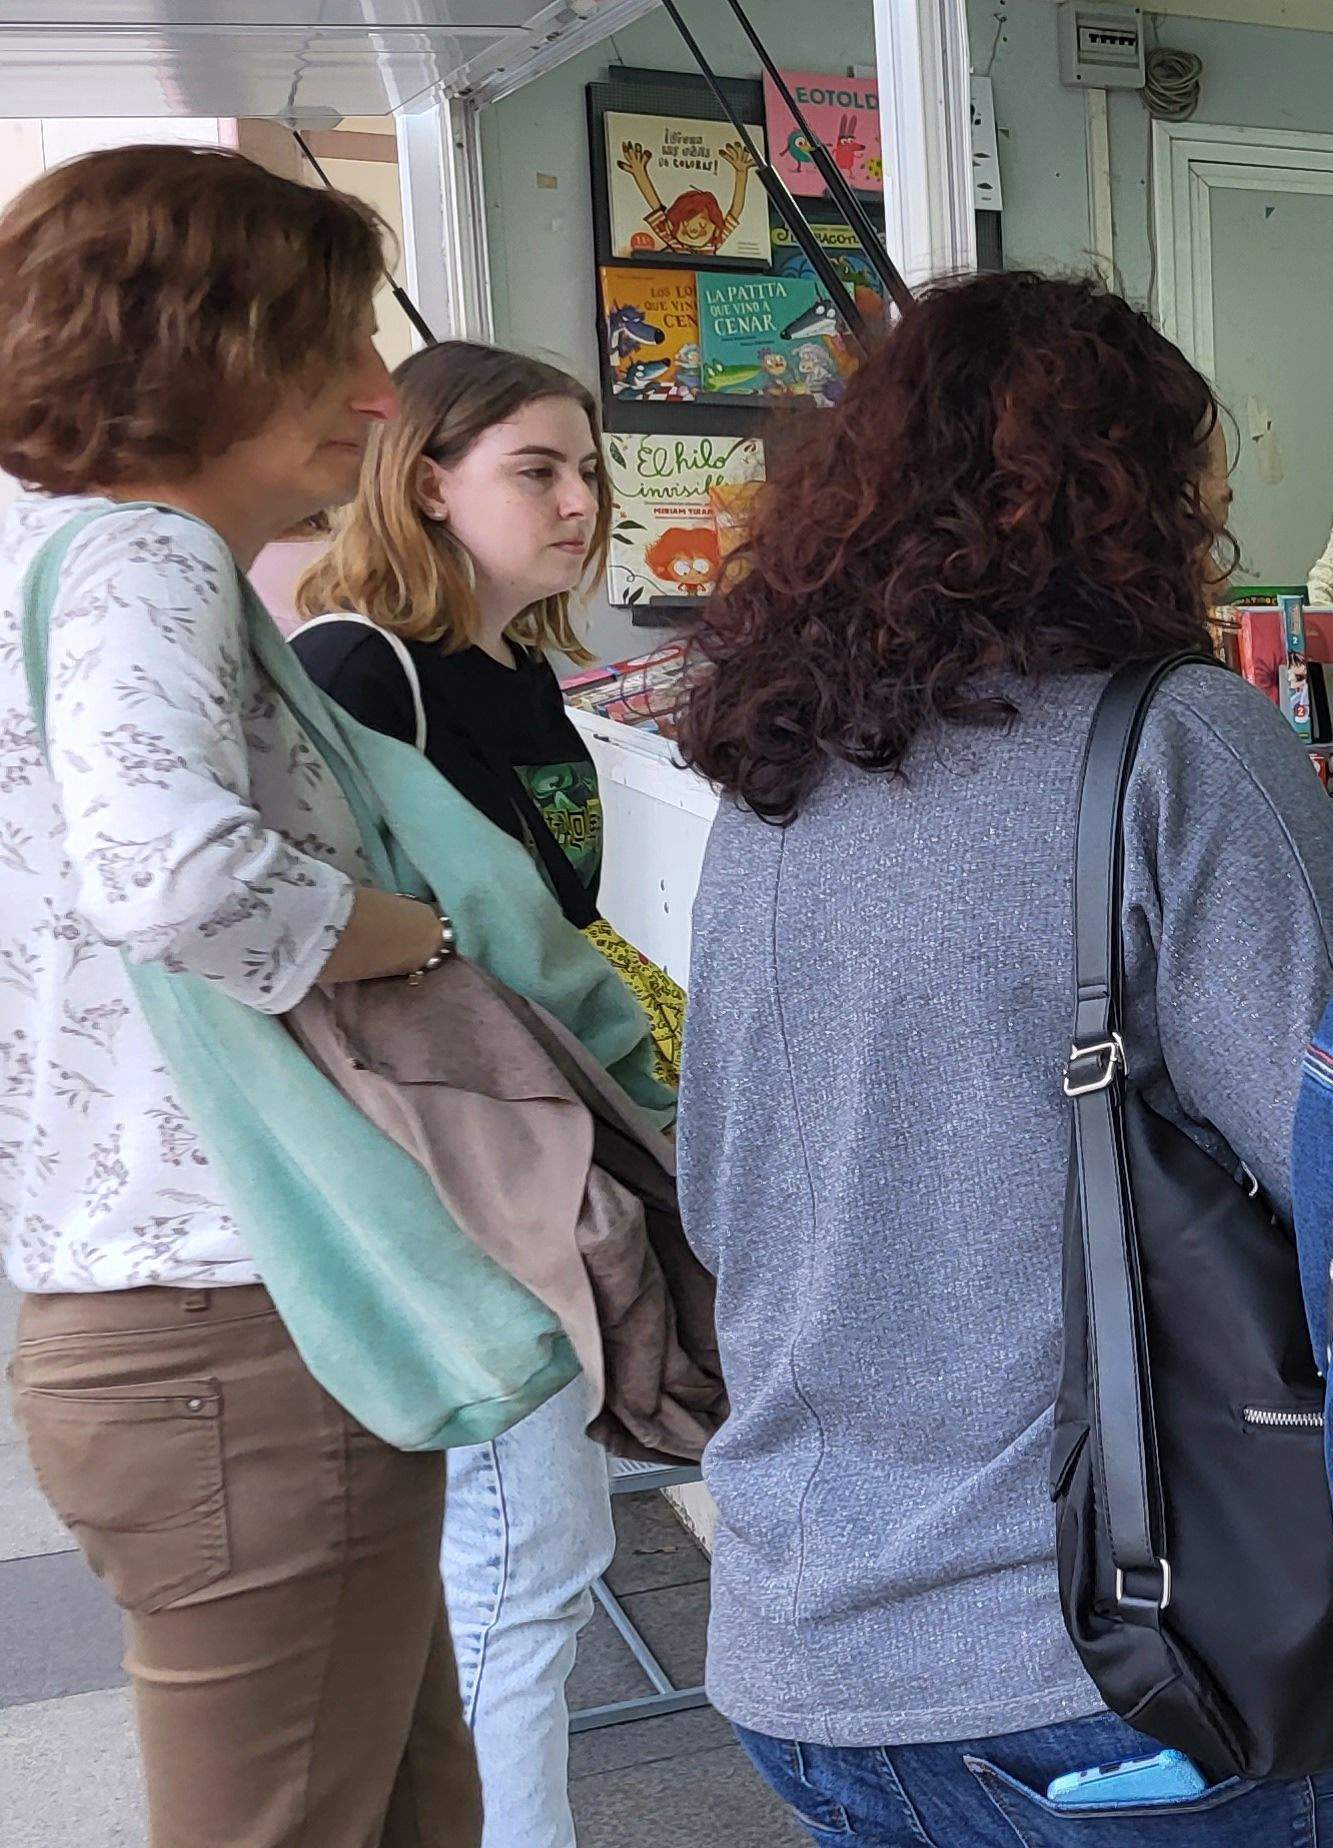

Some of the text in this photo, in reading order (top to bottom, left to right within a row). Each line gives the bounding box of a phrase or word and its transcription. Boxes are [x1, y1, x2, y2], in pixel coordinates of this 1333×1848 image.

[705, 282, 788, 304] LA PATITA
[710, 301, 772, 316] QUE VINO A
[714, 314, 777, 336] CENAR
[675, 438, 728, 474] hilo
[1292, 636, 1299, 645] 2
[1296, 706, 1305, 716] 2
